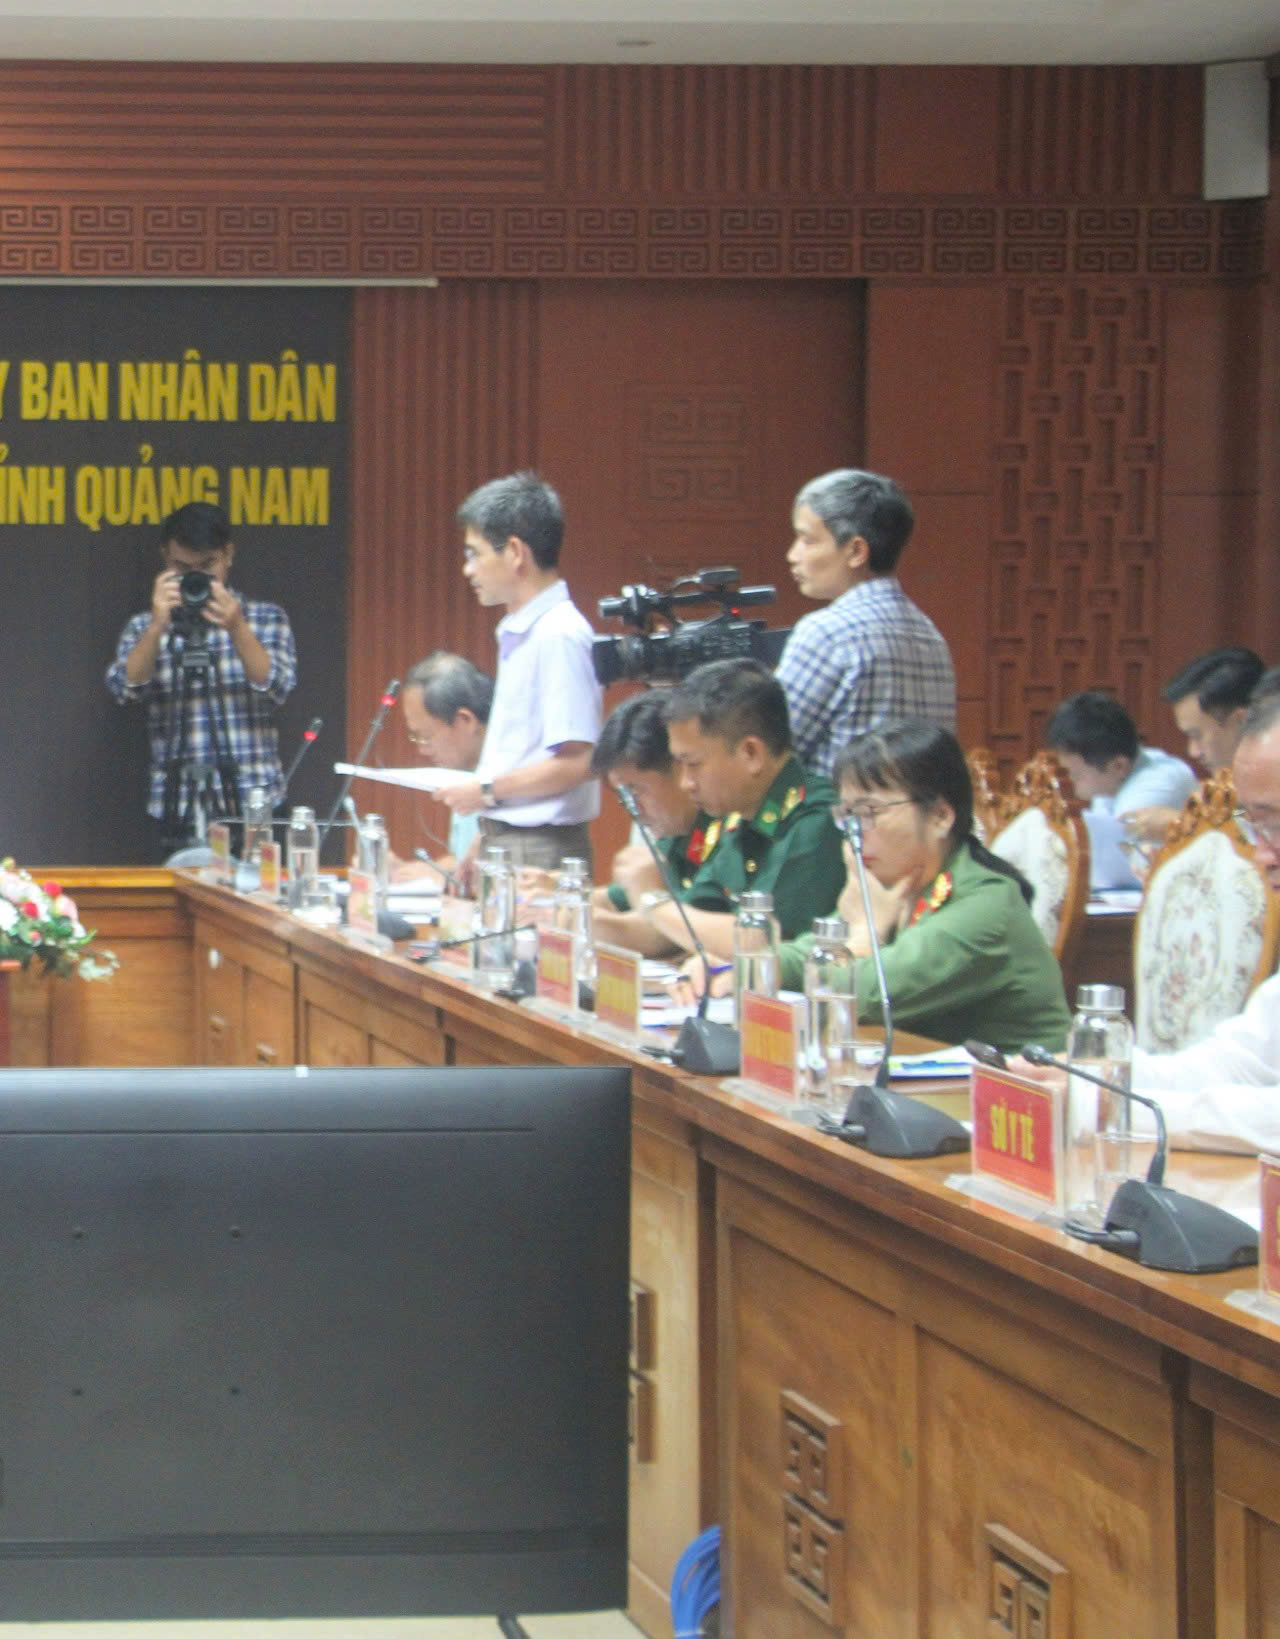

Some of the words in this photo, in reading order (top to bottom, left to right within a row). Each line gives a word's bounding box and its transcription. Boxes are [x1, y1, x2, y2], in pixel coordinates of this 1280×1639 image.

[19, 359, 110, 422] BAN
[118, 348, 239, 422] NHÂN
[247, 348, 337, 422] DÂN
[74, 442, 220, 532] QUẢNG
[229, 466, 330, 526] NAM
